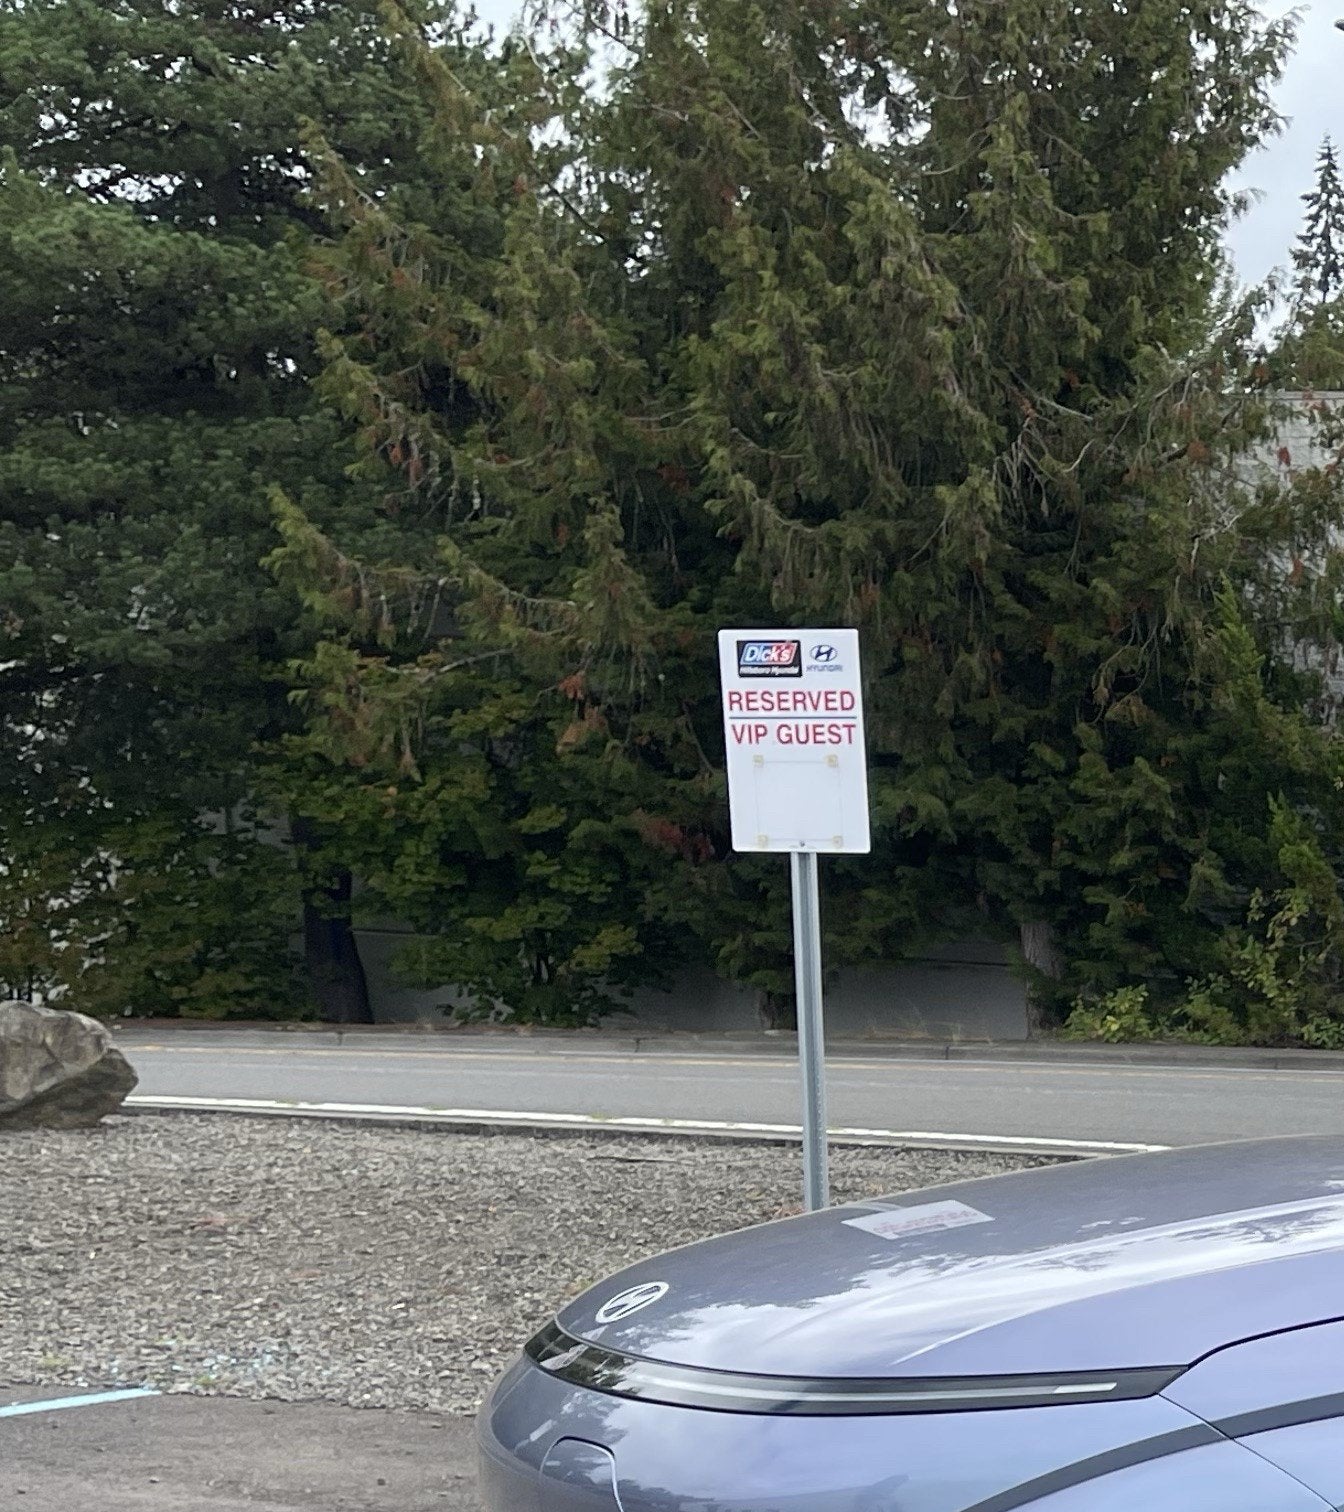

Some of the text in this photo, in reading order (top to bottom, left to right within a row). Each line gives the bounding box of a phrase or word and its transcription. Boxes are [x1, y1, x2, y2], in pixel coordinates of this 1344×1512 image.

[728, 690, 855, 712] RESERVED
[731, 723, 856, 745] VIP GUEST
